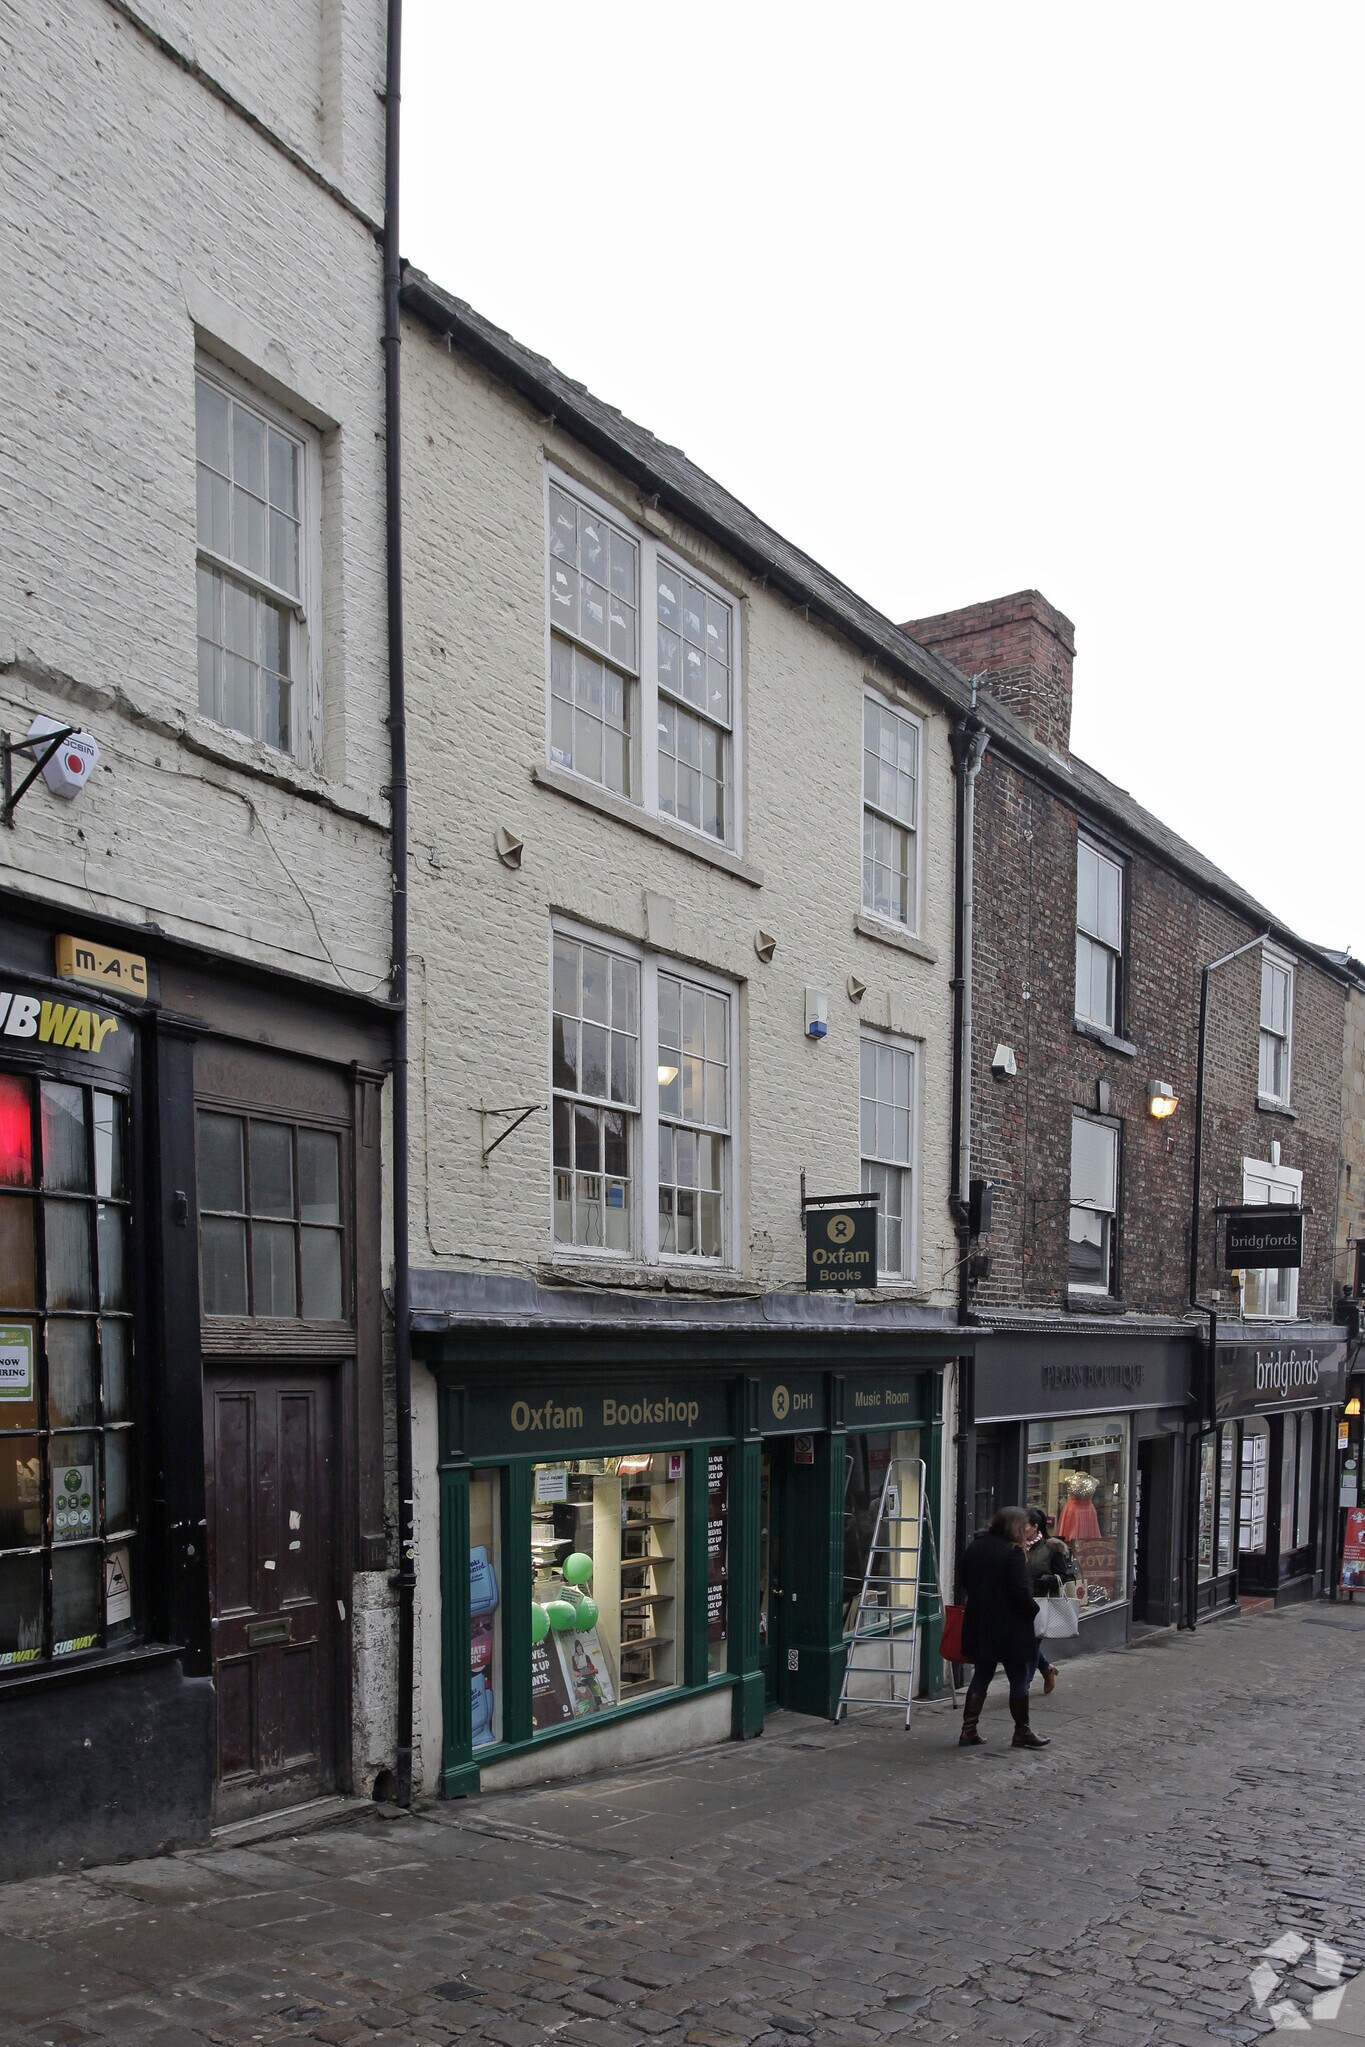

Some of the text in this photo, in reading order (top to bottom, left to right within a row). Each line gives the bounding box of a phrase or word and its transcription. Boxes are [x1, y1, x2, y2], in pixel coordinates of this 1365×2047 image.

[1231, 1233, 1298, 1250] bridgfords
[812, 1248, 870, 1265] Oxfam
[820, 1269, 862, 1281] Books
[1255, 1349, 1320, 1397] bridgfords
[793, 1393, 814, 1410] DH1
[855, 1390, 910, 1407] Music Room
[510, 1397, 699, 1432] Oxfam Bookshop
[1076, 1554, 1116, 1567] LOVE
[53, 1634, 98, 1656] SUBWAY
[540, 1660, 550, 1671] UP
